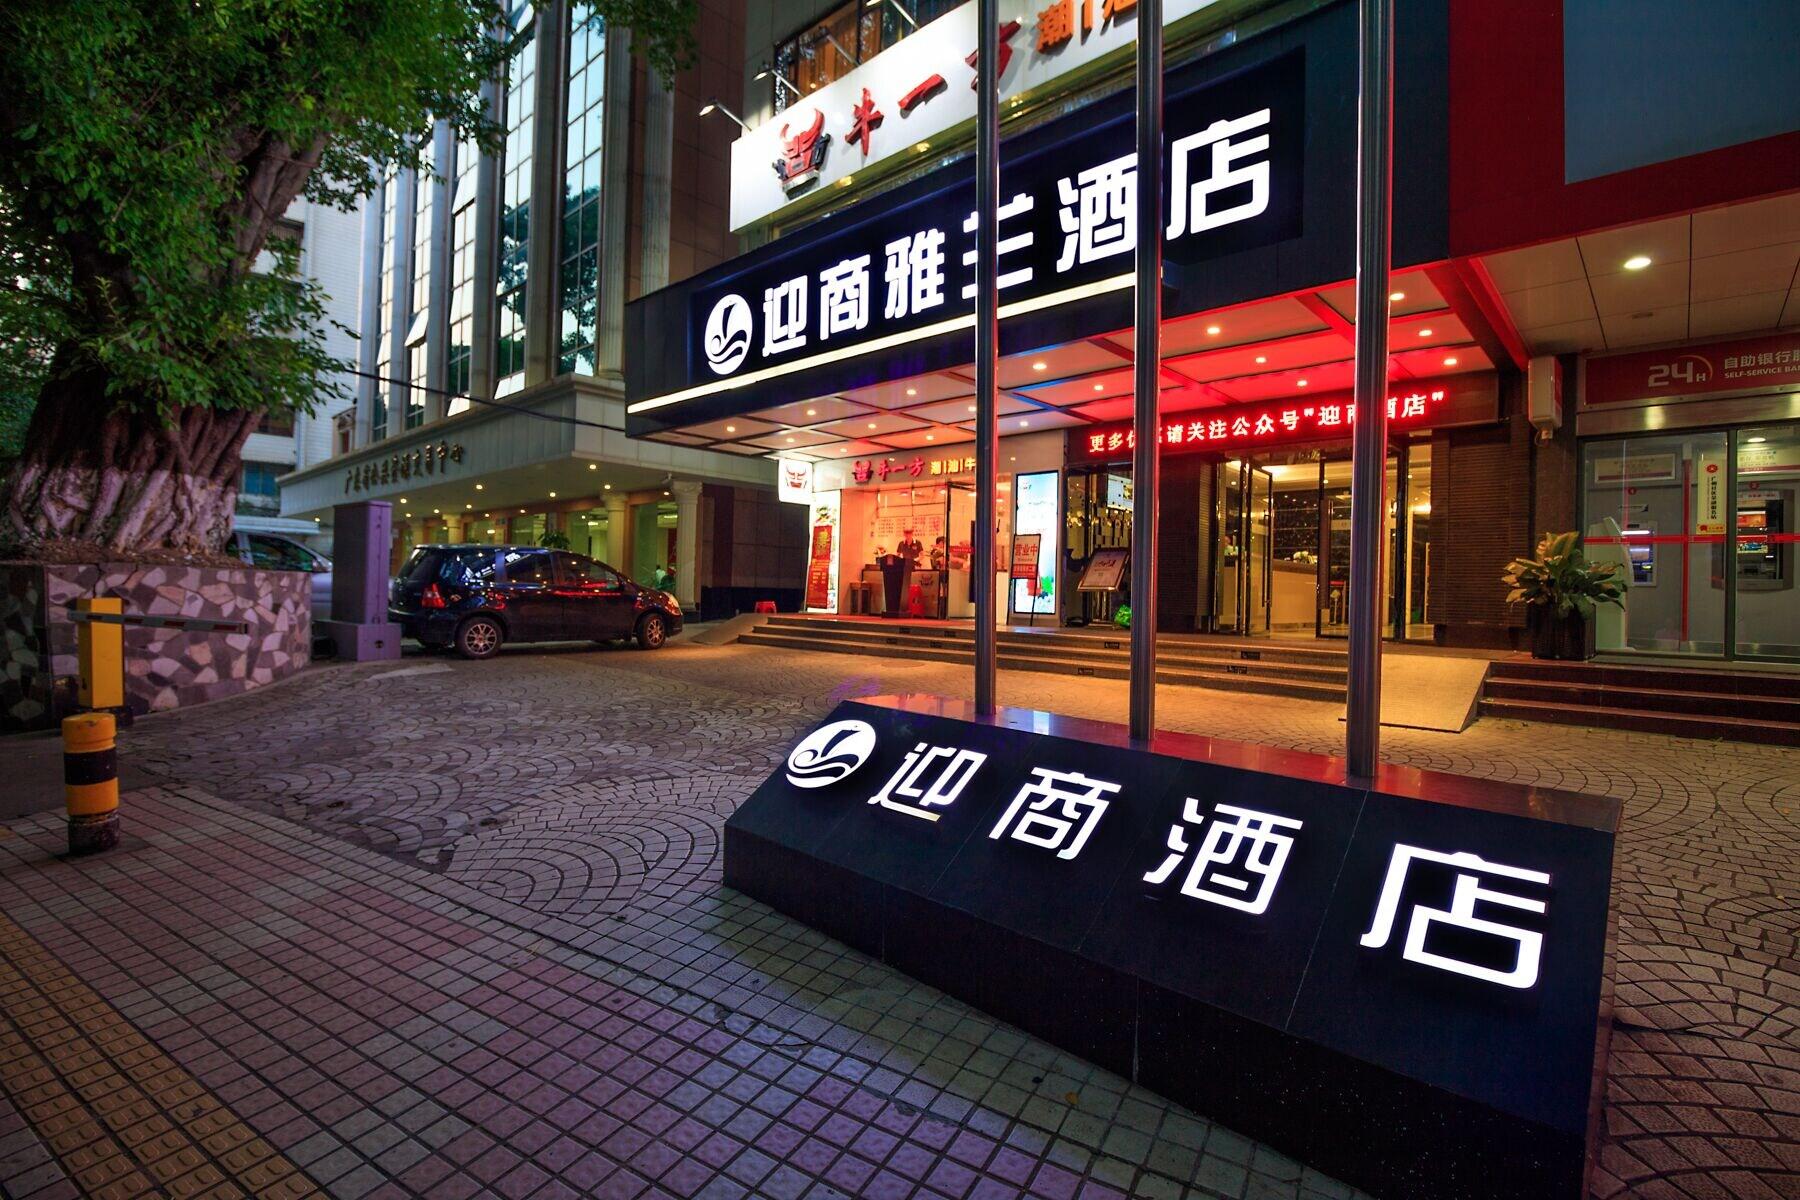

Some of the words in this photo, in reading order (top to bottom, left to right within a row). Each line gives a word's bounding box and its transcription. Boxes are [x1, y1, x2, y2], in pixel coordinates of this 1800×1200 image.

[762, 107, 1271, 358] 迎商雅兰酒店
[1724, 367, 1782, 379] SELF-SERVICE
[867, 742, 1551, 990] 迎商酒店
